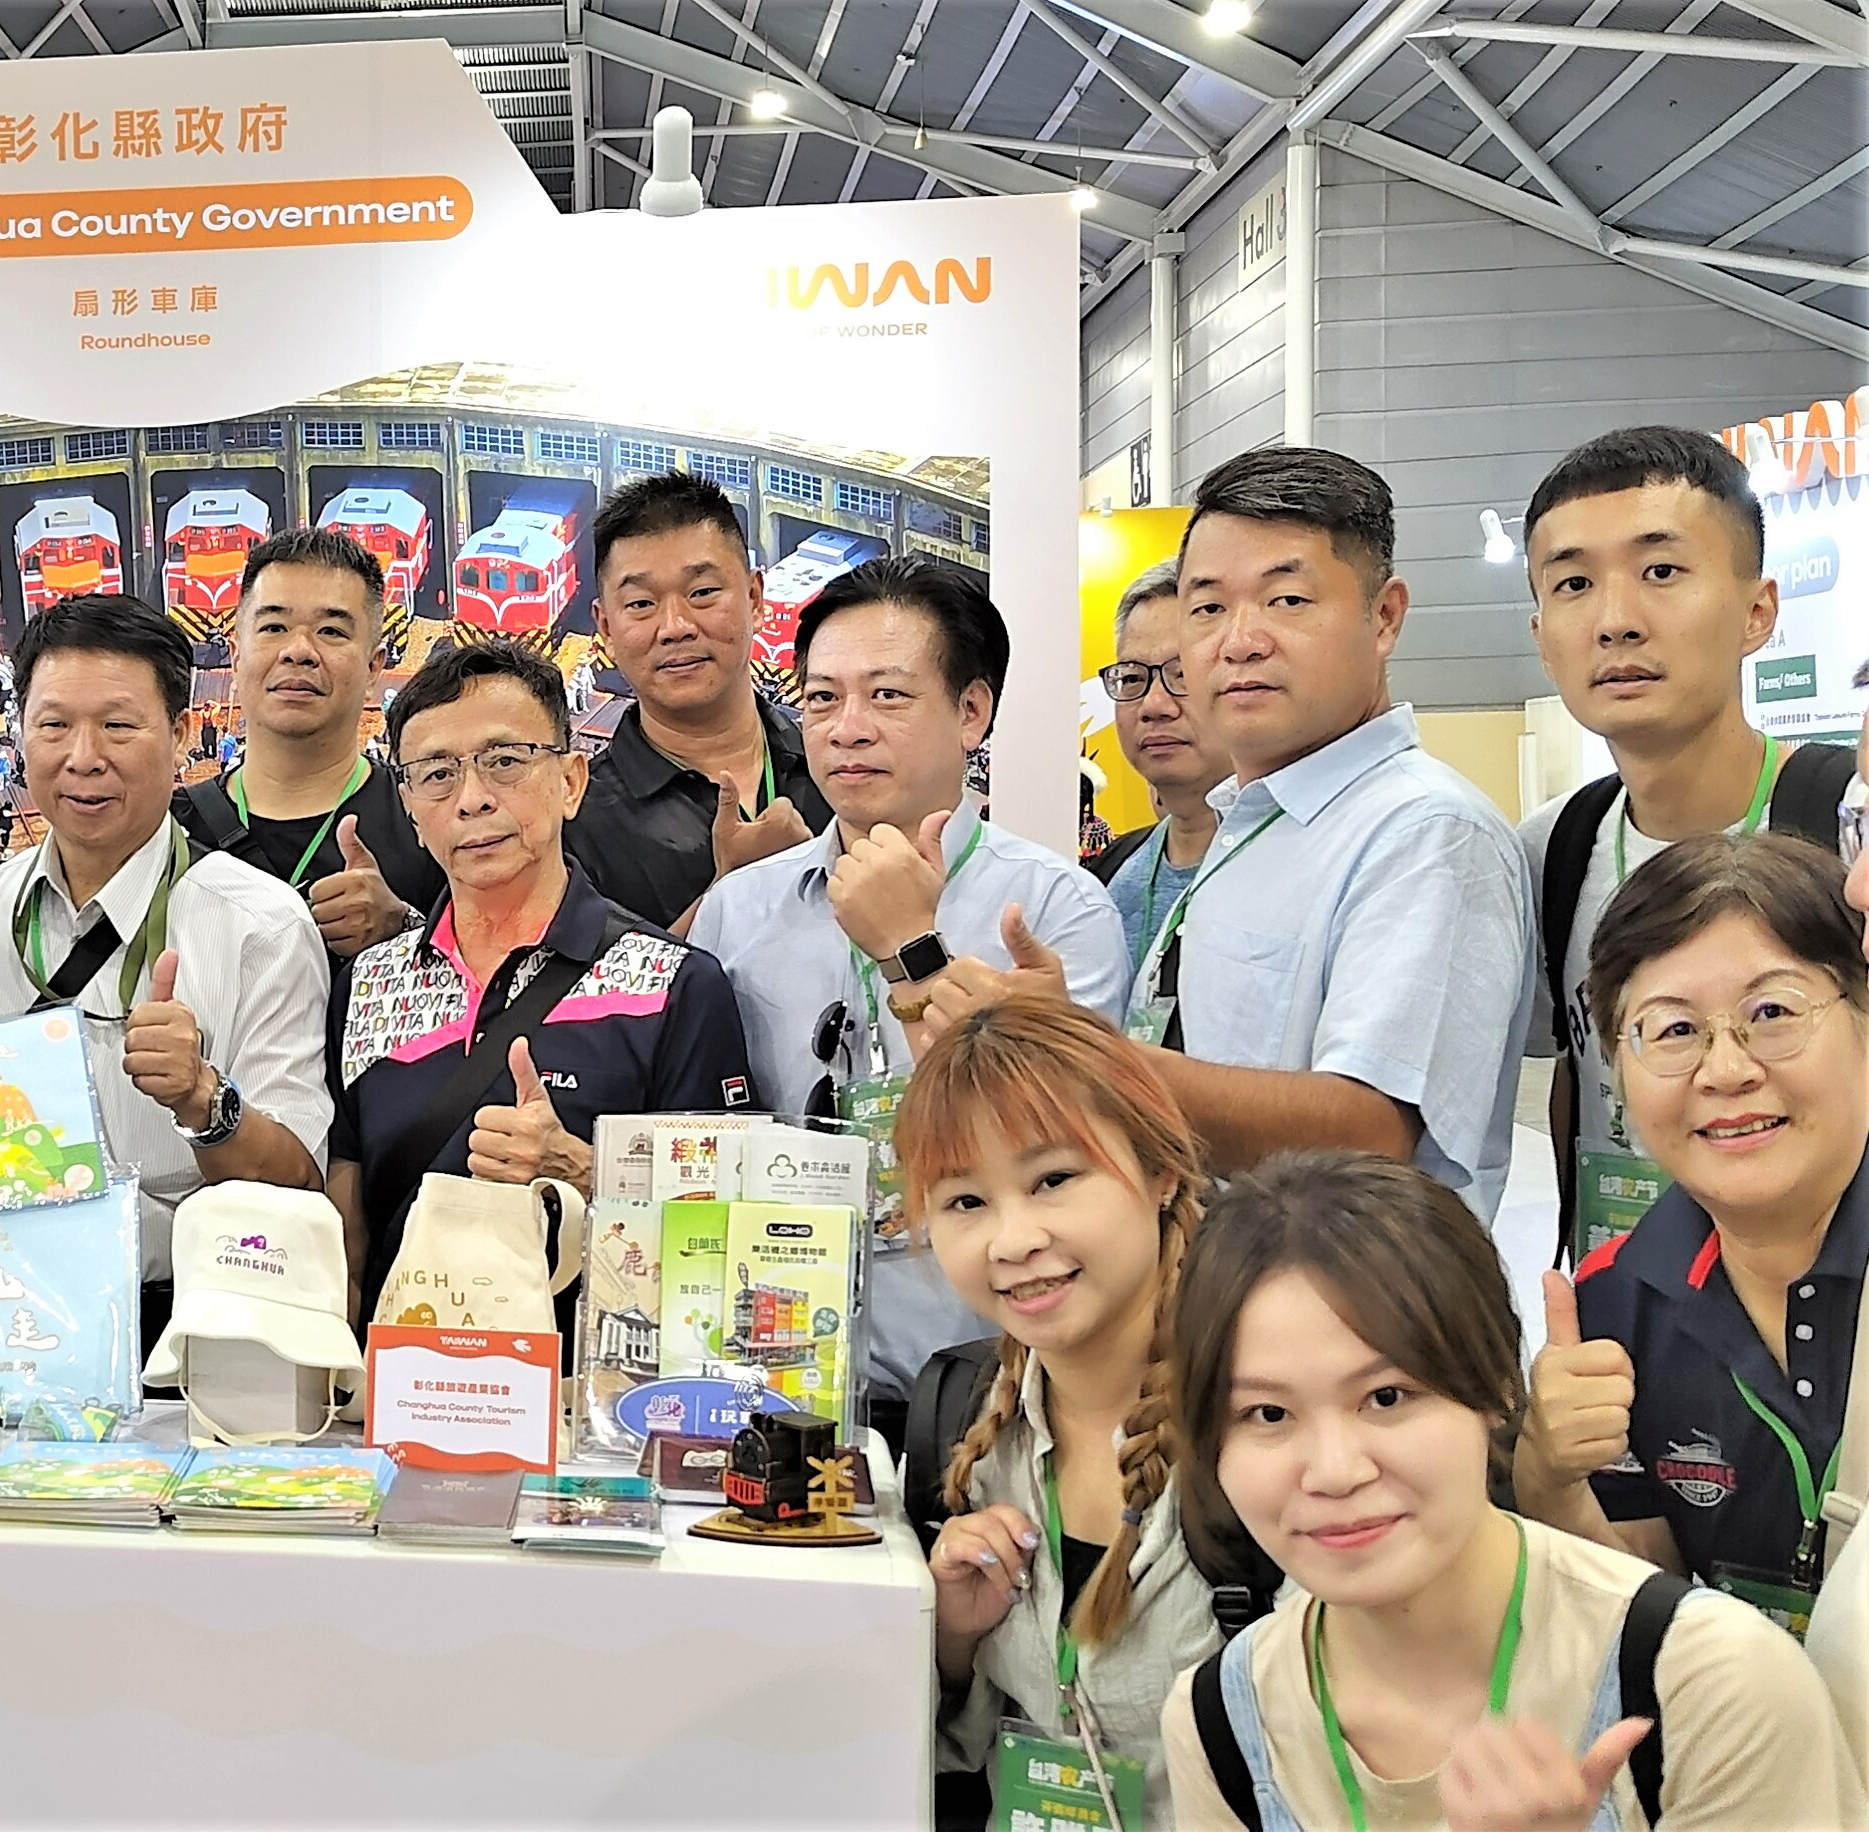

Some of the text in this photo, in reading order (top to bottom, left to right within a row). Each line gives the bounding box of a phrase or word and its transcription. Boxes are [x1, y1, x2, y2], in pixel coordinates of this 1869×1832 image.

[50, 207, 194, 241] County
[202, 193, 455, 233] Government
[1242, 193, 1274, 271] Hall
[767, 256, 992, 310] IWAN
[72, 285, 218, 319] 扇形車庫
[838, 322, 928, 338] WONDER
[80, 331, 212, 351] Roundhouse
[1791, 555, 1832, 590] plan
[392, 991, 445, 1014] NUOVI
[540, 1071, 578, 1089] FILA
[680, 1166, 716, 1179] 觀光
[216, 1255, 284, 1276] CHANGHUA
[439, 1336, 488, 1347] TAIWAN
[397, 1400, 526, 1415] Changhua County Tourism
[411, 1412, 511, 1426] Industry Association
